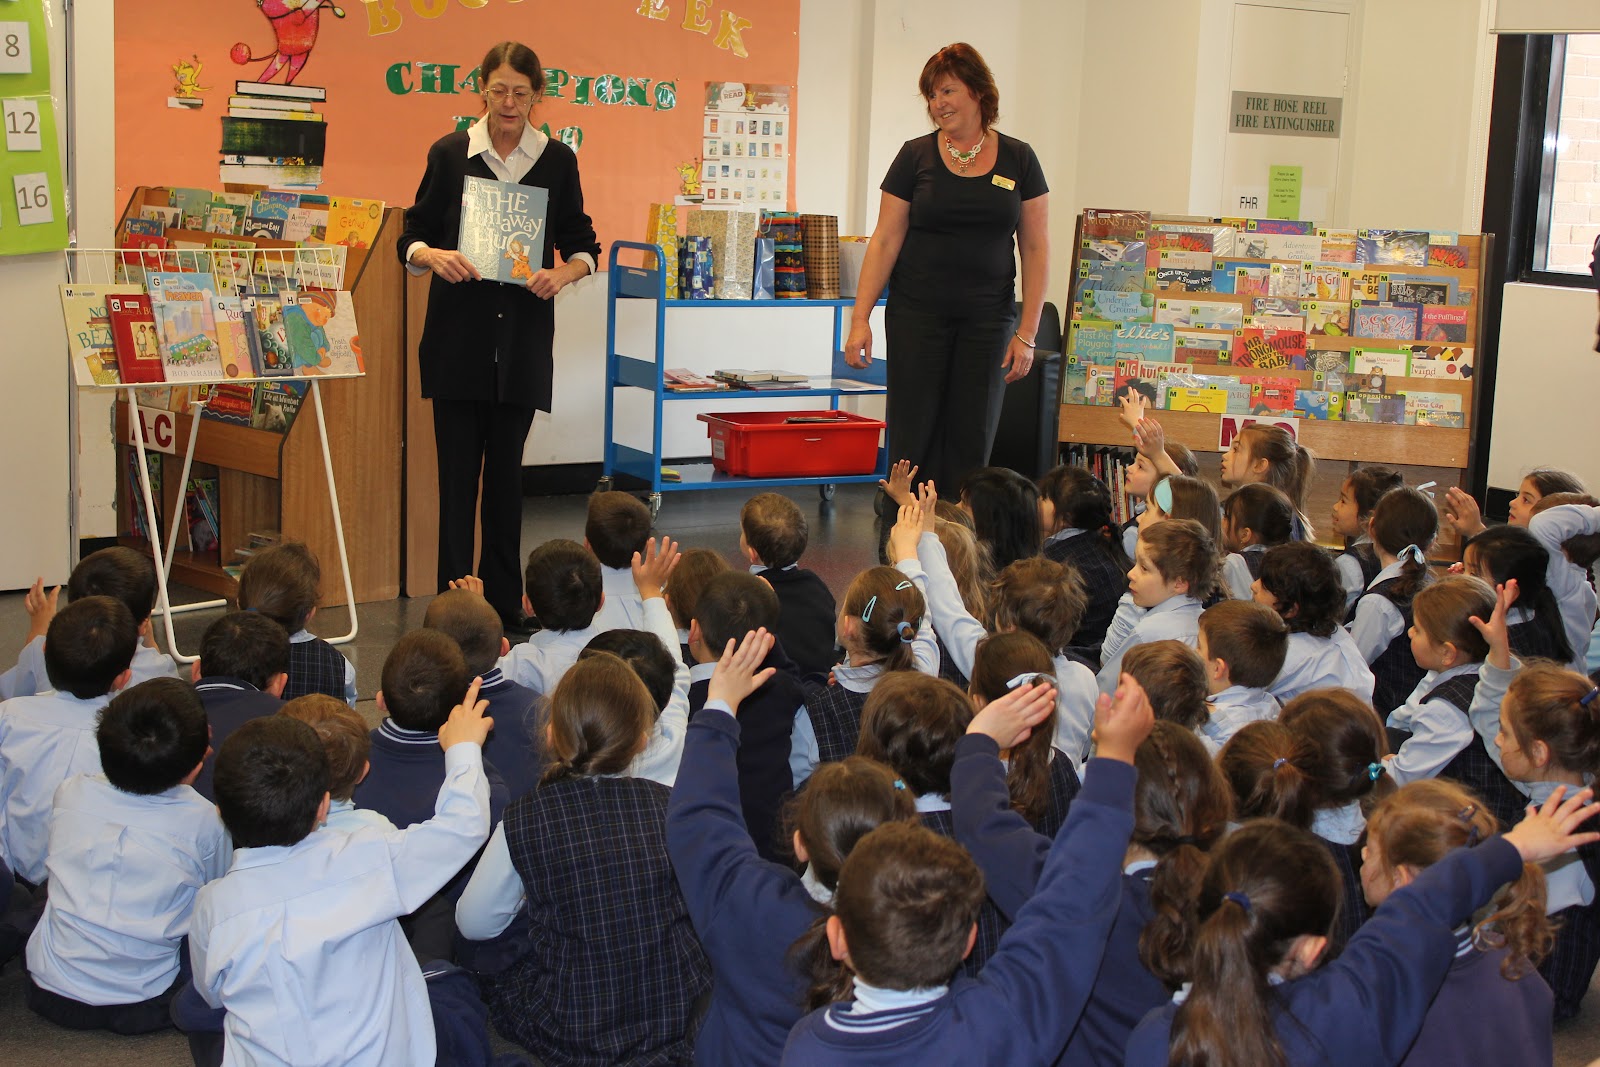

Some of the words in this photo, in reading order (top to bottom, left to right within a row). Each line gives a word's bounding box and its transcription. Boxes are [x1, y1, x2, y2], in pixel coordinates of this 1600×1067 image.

[5, 34, 20, 57] 8
[385, 60, 677, 111] CHAPIONS
[724, 91, 743, 99] READ
[1246, 97, 1269, 111] FIRE
[1273, 99, 1298, 113] HOSE
[1302, 101, 1327, 115] REEL
[7, 111, 37, 134] 12
[1235, 114, 1259, 128] FIRE
[1263, 115, 1335, 133] EXTINGUISHER
[18, 185, 48, 209] 16
[482, 188, 529, 214] THE
[1240, 196, 1258, 209] FHR
[1305, 272, 1322, 284] The
[1325, 274, 1340, 284] Gri
[1362, 274, 1379, 284] GET
[165, 290, 203, 301] heaven
[1367, 286, 1378, 294] BE
[113, 302, 119, 310] G
[143, 307, 152, 315] BO
[1109, 304, 1138, 313] Ground
[77, 329, 113, 348] BEA
[1079, 331, 1096, 339] First
[1117, 326, 1170, 340] Ellie's
[1078, 339, 1114, 349] Playgrou
[1243, 336, 1261, 351] MR
[1259, 354, 1272, 362] AND
[1259, 354, 1293, 369] BABY
